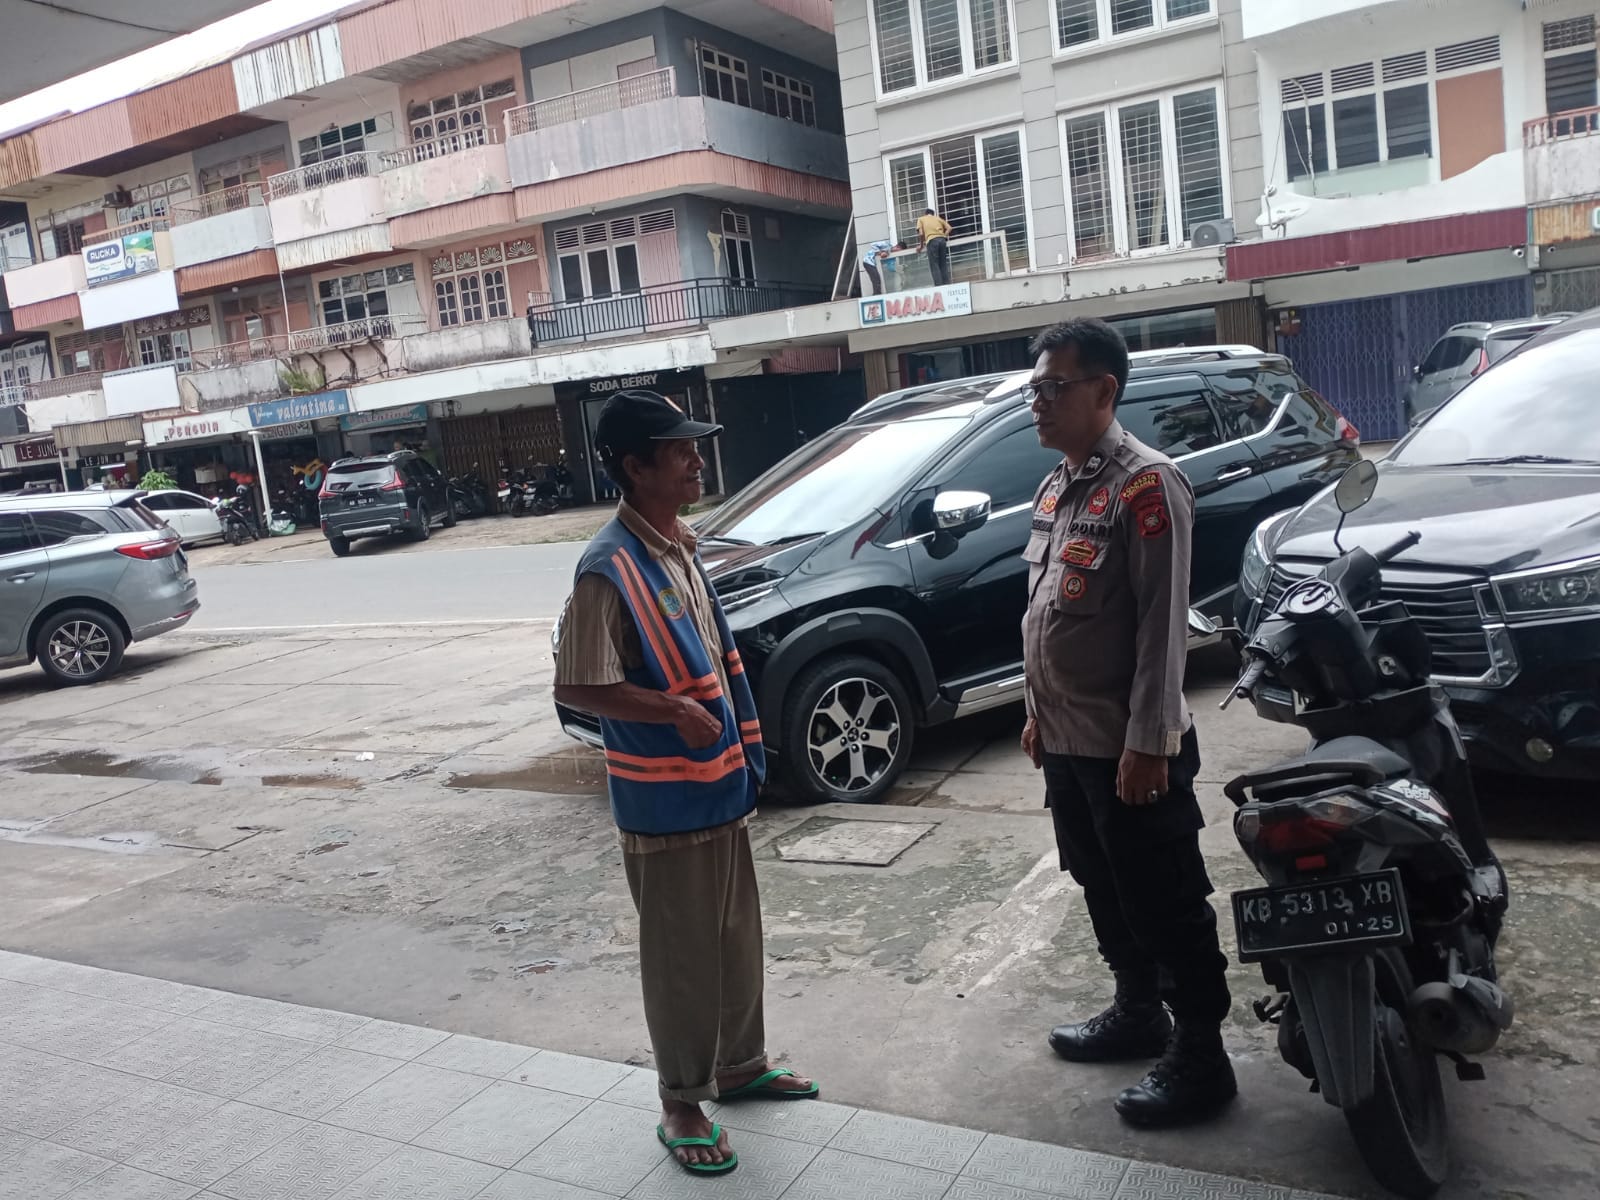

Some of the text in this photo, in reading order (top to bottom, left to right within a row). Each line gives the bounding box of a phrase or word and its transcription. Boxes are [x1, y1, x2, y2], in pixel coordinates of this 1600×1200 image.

[90, 248, 115, 260] RUCIKA
[886, 292, 945, 319] MAMA
[589, 373, 658, 393] SODA BERRY
[19, 445, 34, 460] LE
[1070, 521, 1112, 537] POLRI
[1241, 880, 1393, 924] KB 5313 XB
